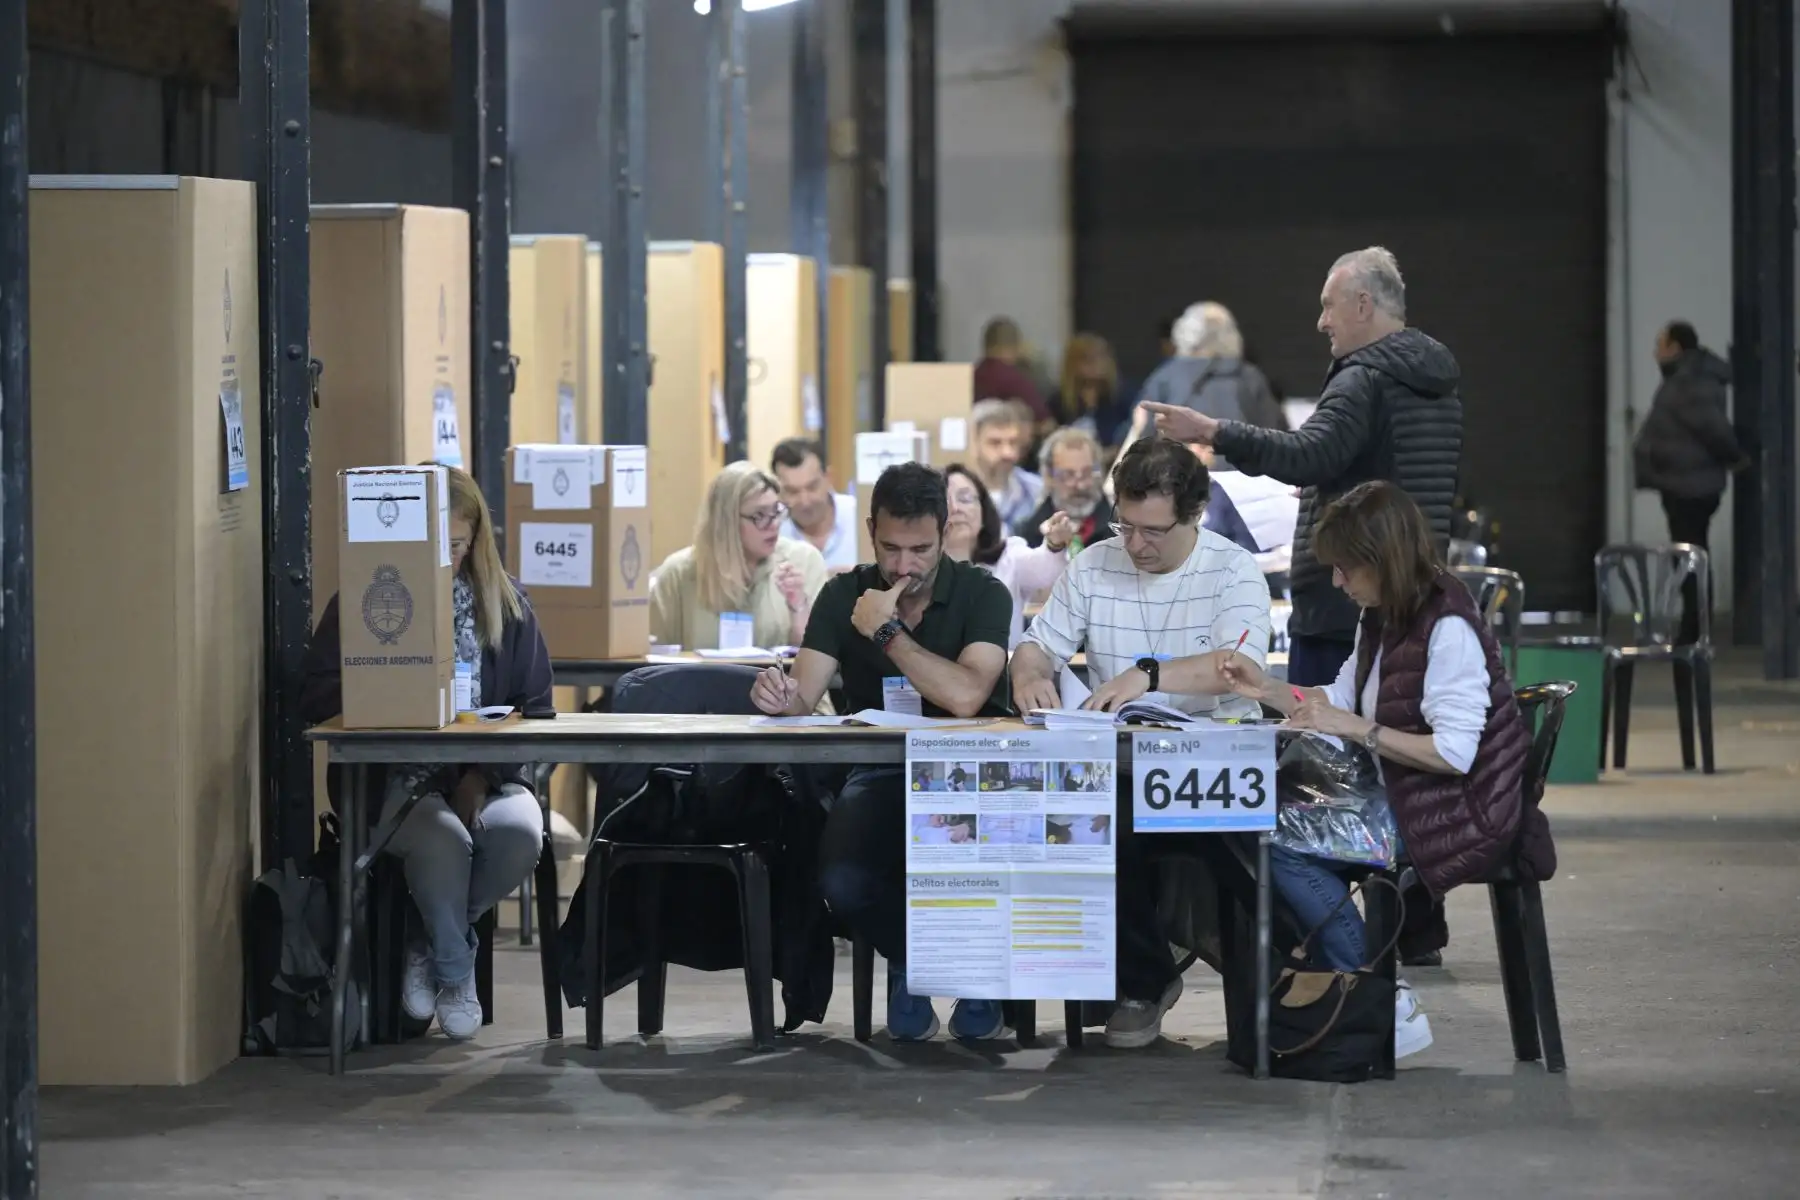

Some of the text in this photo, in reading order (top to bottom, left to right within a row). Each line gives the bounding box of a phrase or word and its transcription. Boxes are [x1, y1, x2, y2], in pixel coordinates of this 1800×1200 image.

[534, 540, 577, 558] 6445
[344, 655, 433, 666] ELECCIONES ARGENTINAS
[911, 737, 976, 748] Disposiciones
[1144, 767, 1266, 810] 6443
[911, 876, 1000, 888] Delitos electorales
